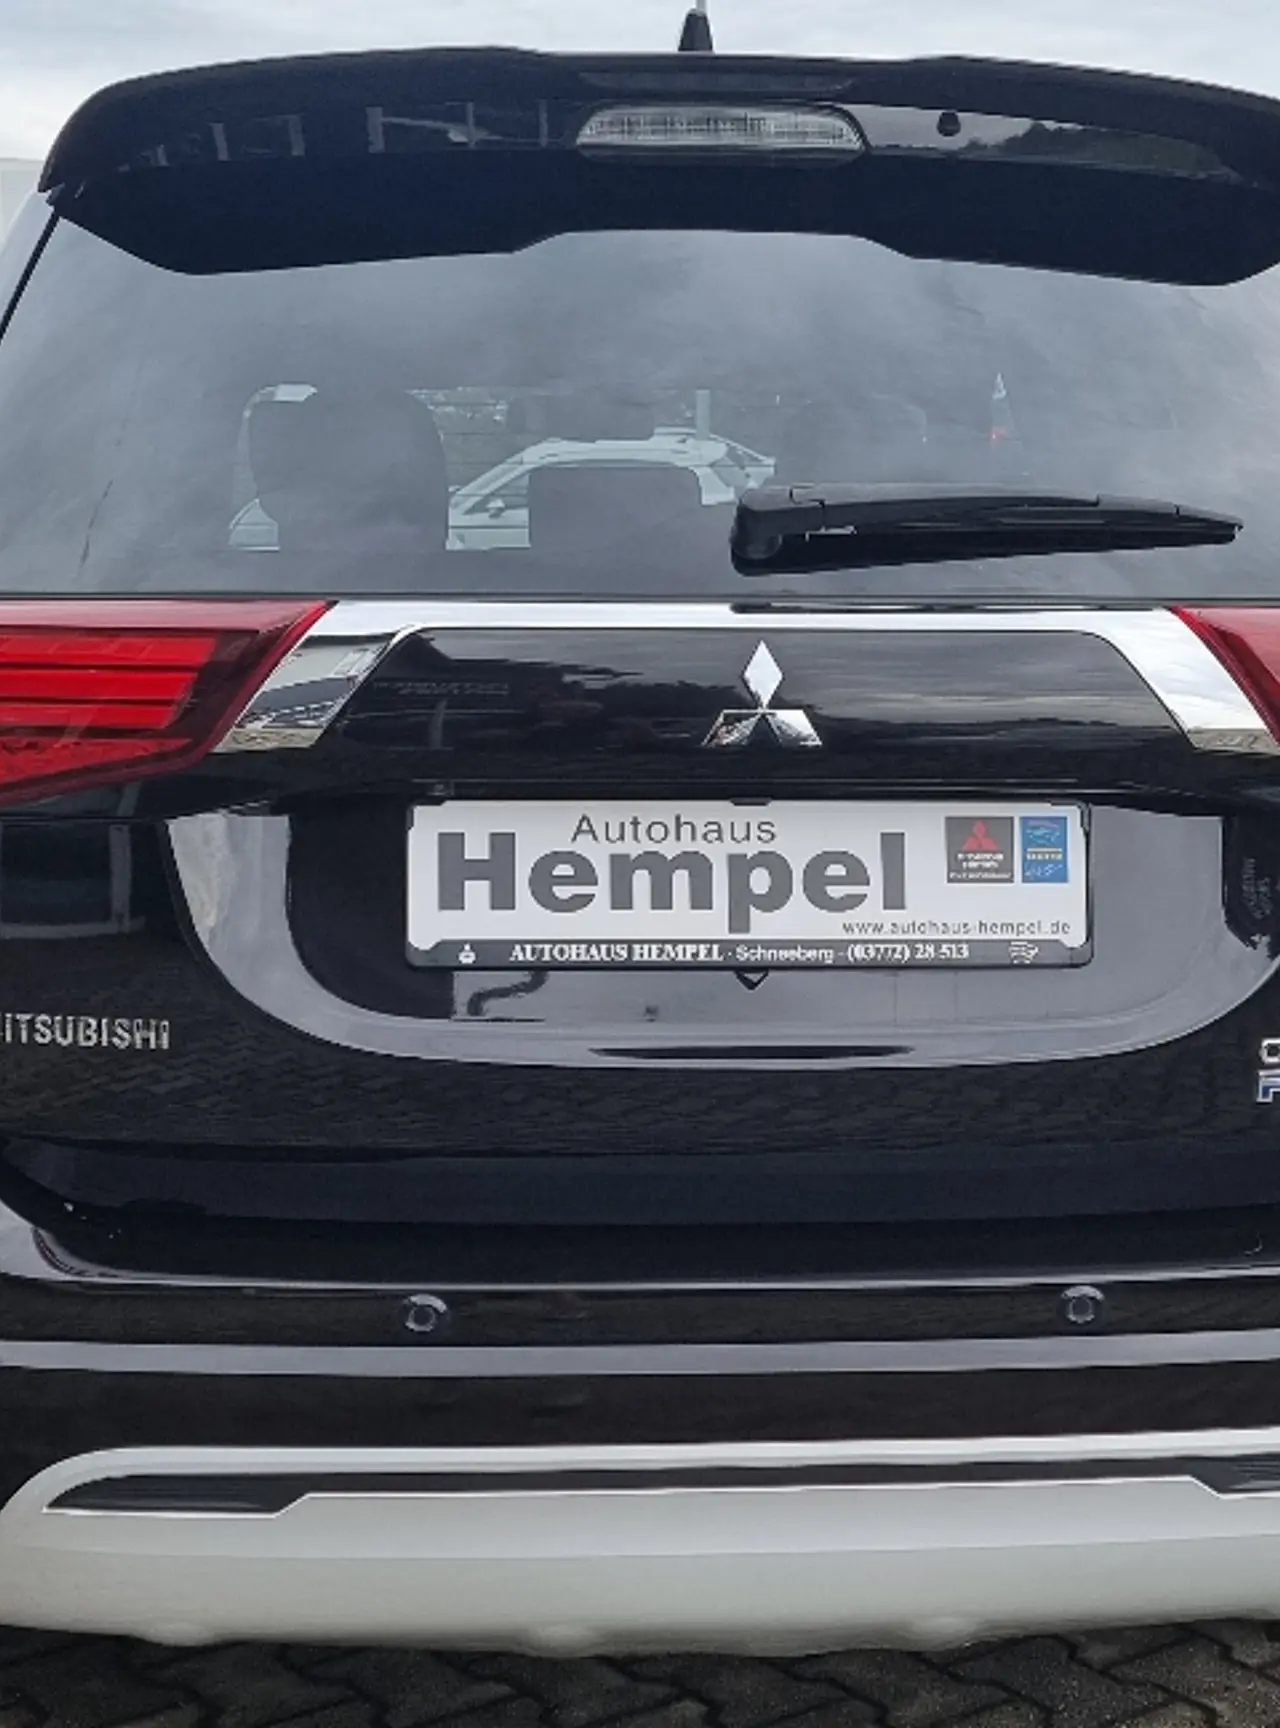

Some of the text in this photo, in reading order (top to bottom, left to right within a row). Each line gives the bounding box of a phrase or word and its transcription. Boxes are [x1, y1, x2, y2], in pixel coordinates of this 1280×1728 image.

[571, 813, 777, 844] Autohaus
[437, 831, 907, 934] Hempel
[842, 919, 1071, 937] www.autohaus-hempel.de
[509, 943, 629, 962] AUTOHAUS
[631, 944, 724, 962] HEMPEL
[735, 944, 834, 964] Schneeberg
[914, 943, 935, 960] 28
[938, 943, 970, 959] 513
